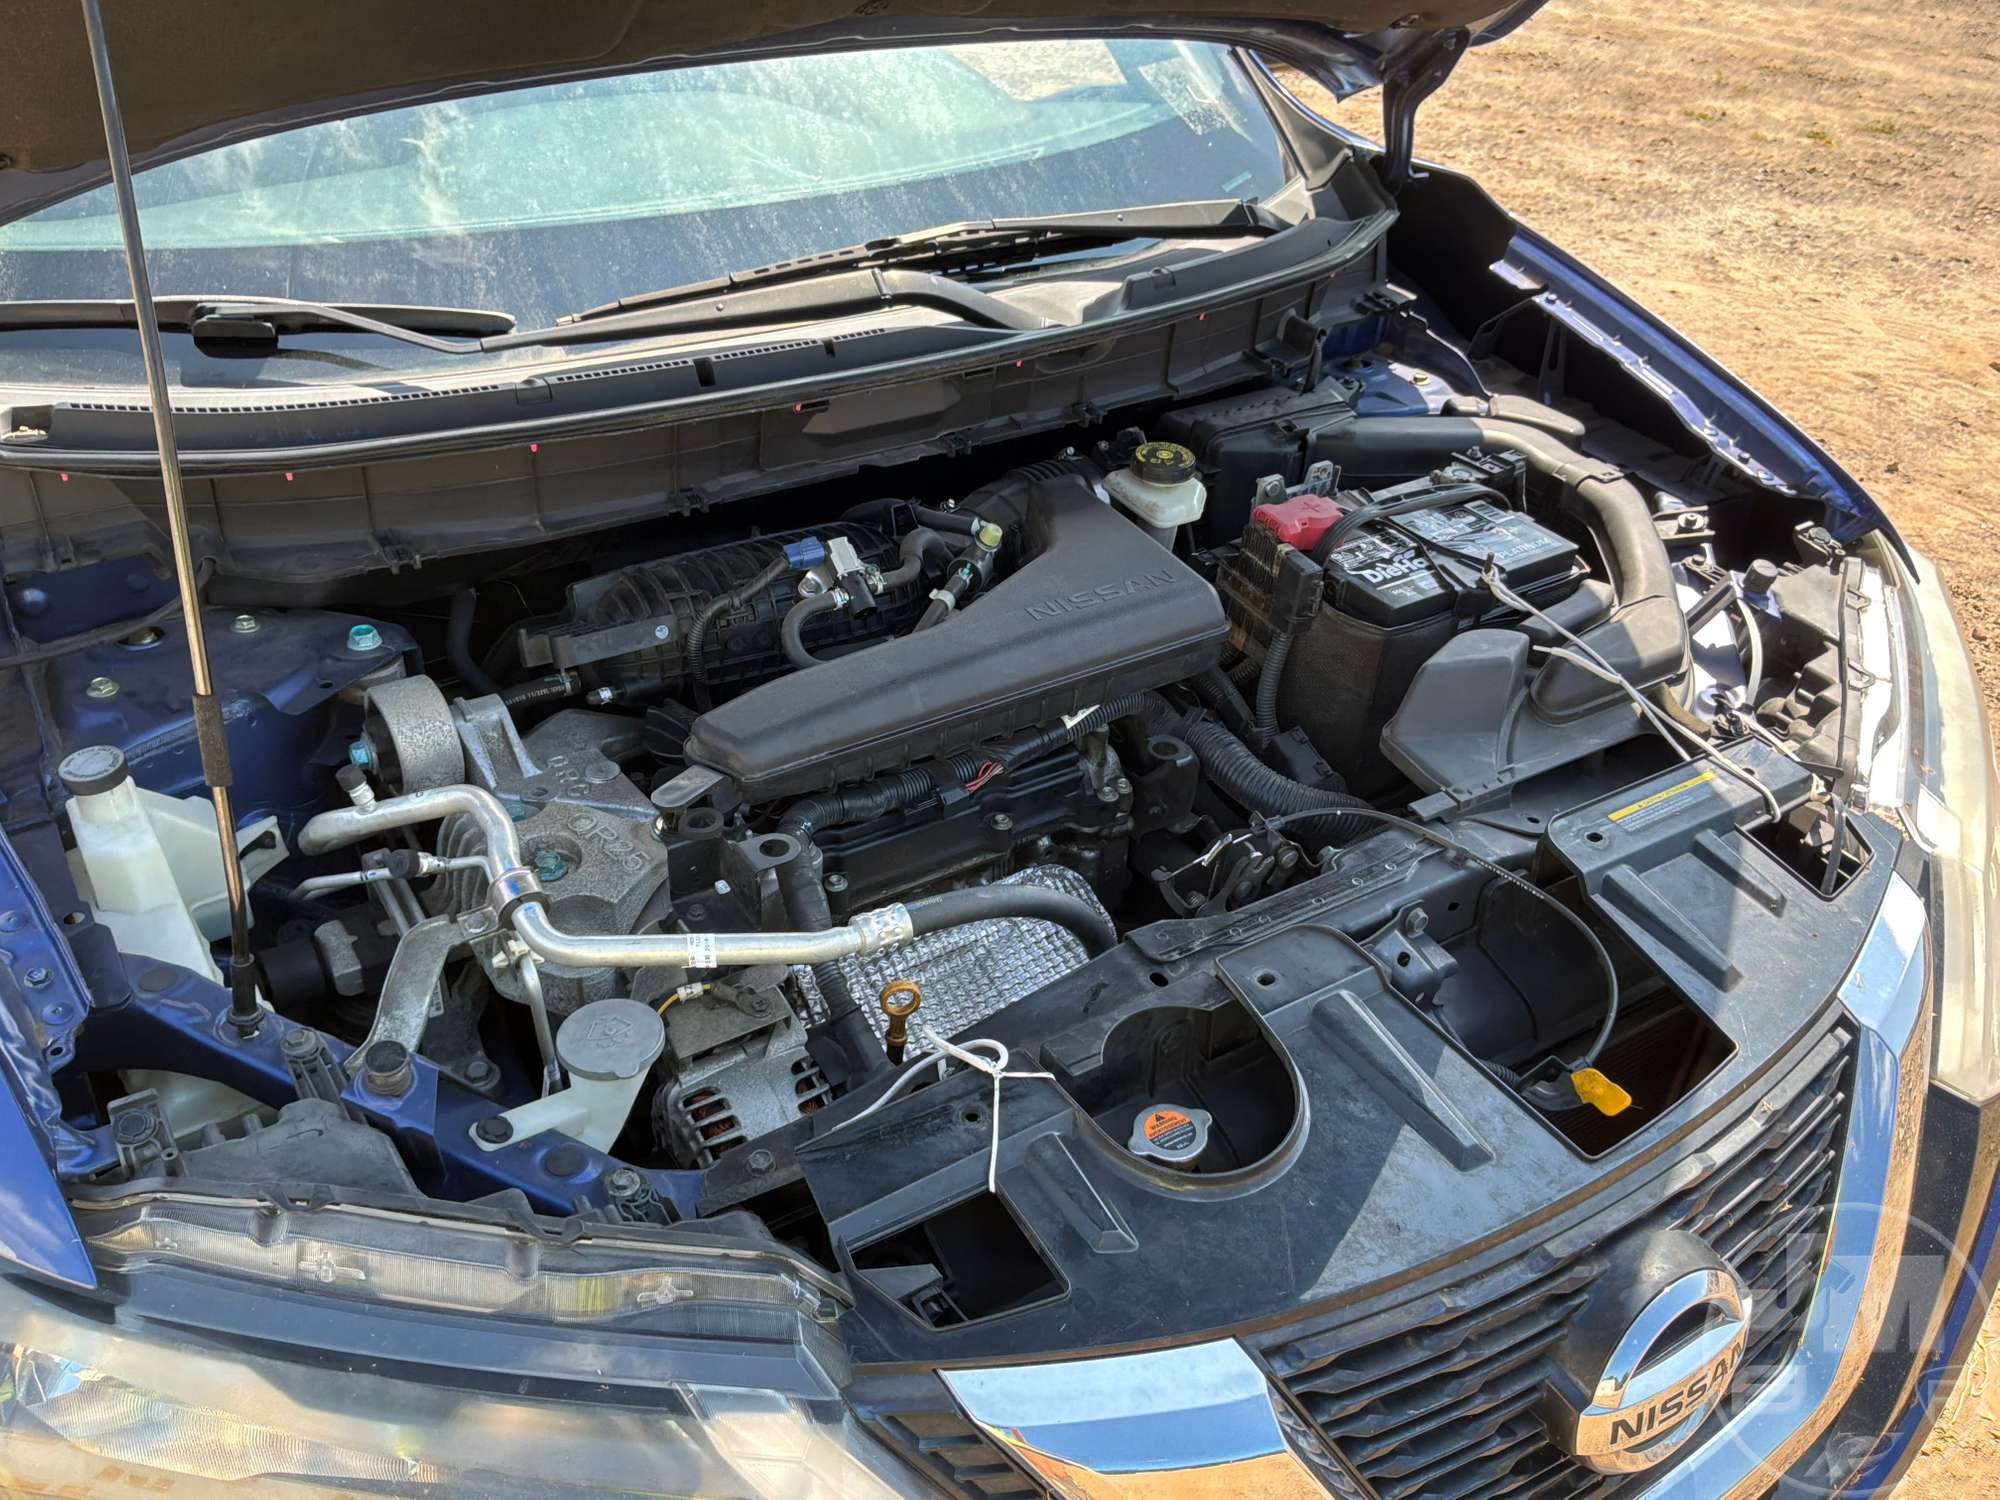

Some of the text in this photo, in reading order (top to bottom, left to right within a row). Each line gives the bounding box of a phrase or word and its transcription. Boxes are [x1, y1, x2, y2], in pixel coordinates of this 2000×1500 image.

[1024, 568, 1176, 621] NISSAN
[1361, 557, 1429, 584] DieHa
[567, 812, 653, 872] QR25
[1609, 1341, 1743, 1446] NISSAN
